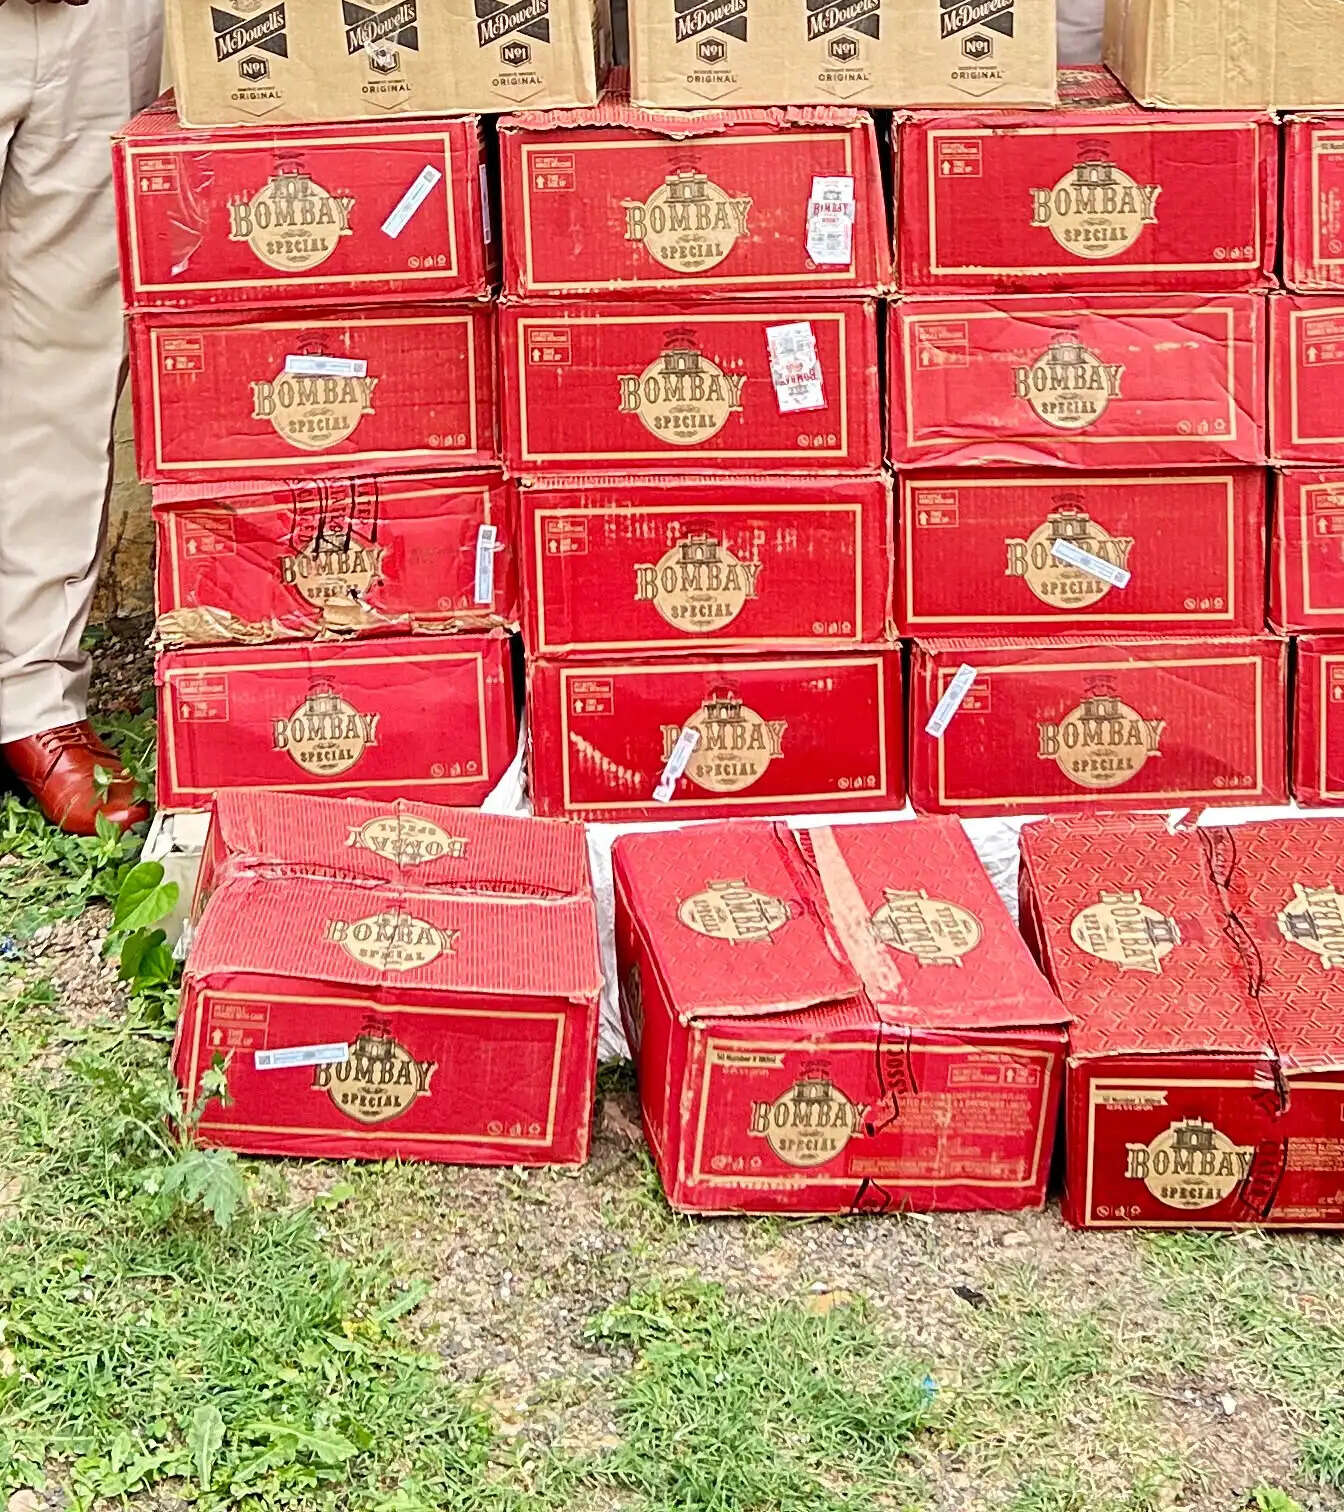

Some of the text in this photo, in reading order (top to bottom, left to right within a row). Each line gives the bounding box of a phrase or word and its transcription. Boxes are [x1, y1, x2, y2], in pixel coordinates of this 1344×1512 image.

[218, 10, 286, 52] McDowell's
[491, 75, 542, 86] ORIGINAL
[686, 73, 737, 84] ORIGINAL
[818, 72, 870, 82] ORIGINAL
[951, 70, 1002, 80] ORIGINAL
[231, 90, 280, 102] ORIGINAL
[361, 83, 411, 94] ORIGINAL
[1031, 186, 1160, 224] BOMBAY
[233, 198, 355, 237] BOMBAY
[626, 201, 752, 238] BOMBAY
[1064, 227, 1128, 242] SPECIAL
[266, 239, 329, 255] SPECIAL
[661, 243, 723, 259] SPECIAL
[1013, 364, 1124, 398] BOMBAY
[253, 378, 376, 418] BOMBAY
[619, 374, 746, 412] BOMBAY
[1042, 400, 1097, 414] SPECIAL
[288, 417, 350, 434] SPECIAL
[654, 414, 717, 430] SPECIAL
[637, 564, 761, 600] BOMBAY
[1041, 581, 1103, 595] SPECIAL
[671, 603, 733, 618] SPECIAL
[273, 714, 379, 749] BOMBAY
[1039, 721, 1164, 756] BOMBAY
[301, 749, 353, 762] SPECIAL
[696, 763, 757, 777] SPECIAL
[1073, 758, 1133, 772] SPECIAL
[883, 889, 962, 967] BOMBAY
[1100, 890, 1163, 973] BOMBAY
[328, 920, 459, 953] BOMBAY
[312, 1055, 435, 1091] BOMBAY
[341, 1093, 401, 1107] SPECIAL
[750, 1101, 870, 1134] BOMBAY
[779, 1139, 837, 1151] SPECIAL
[1127, 1149, 1253, 1178] BOMBAY
[1161, 1187, 1223, 1199] SPECIAL
